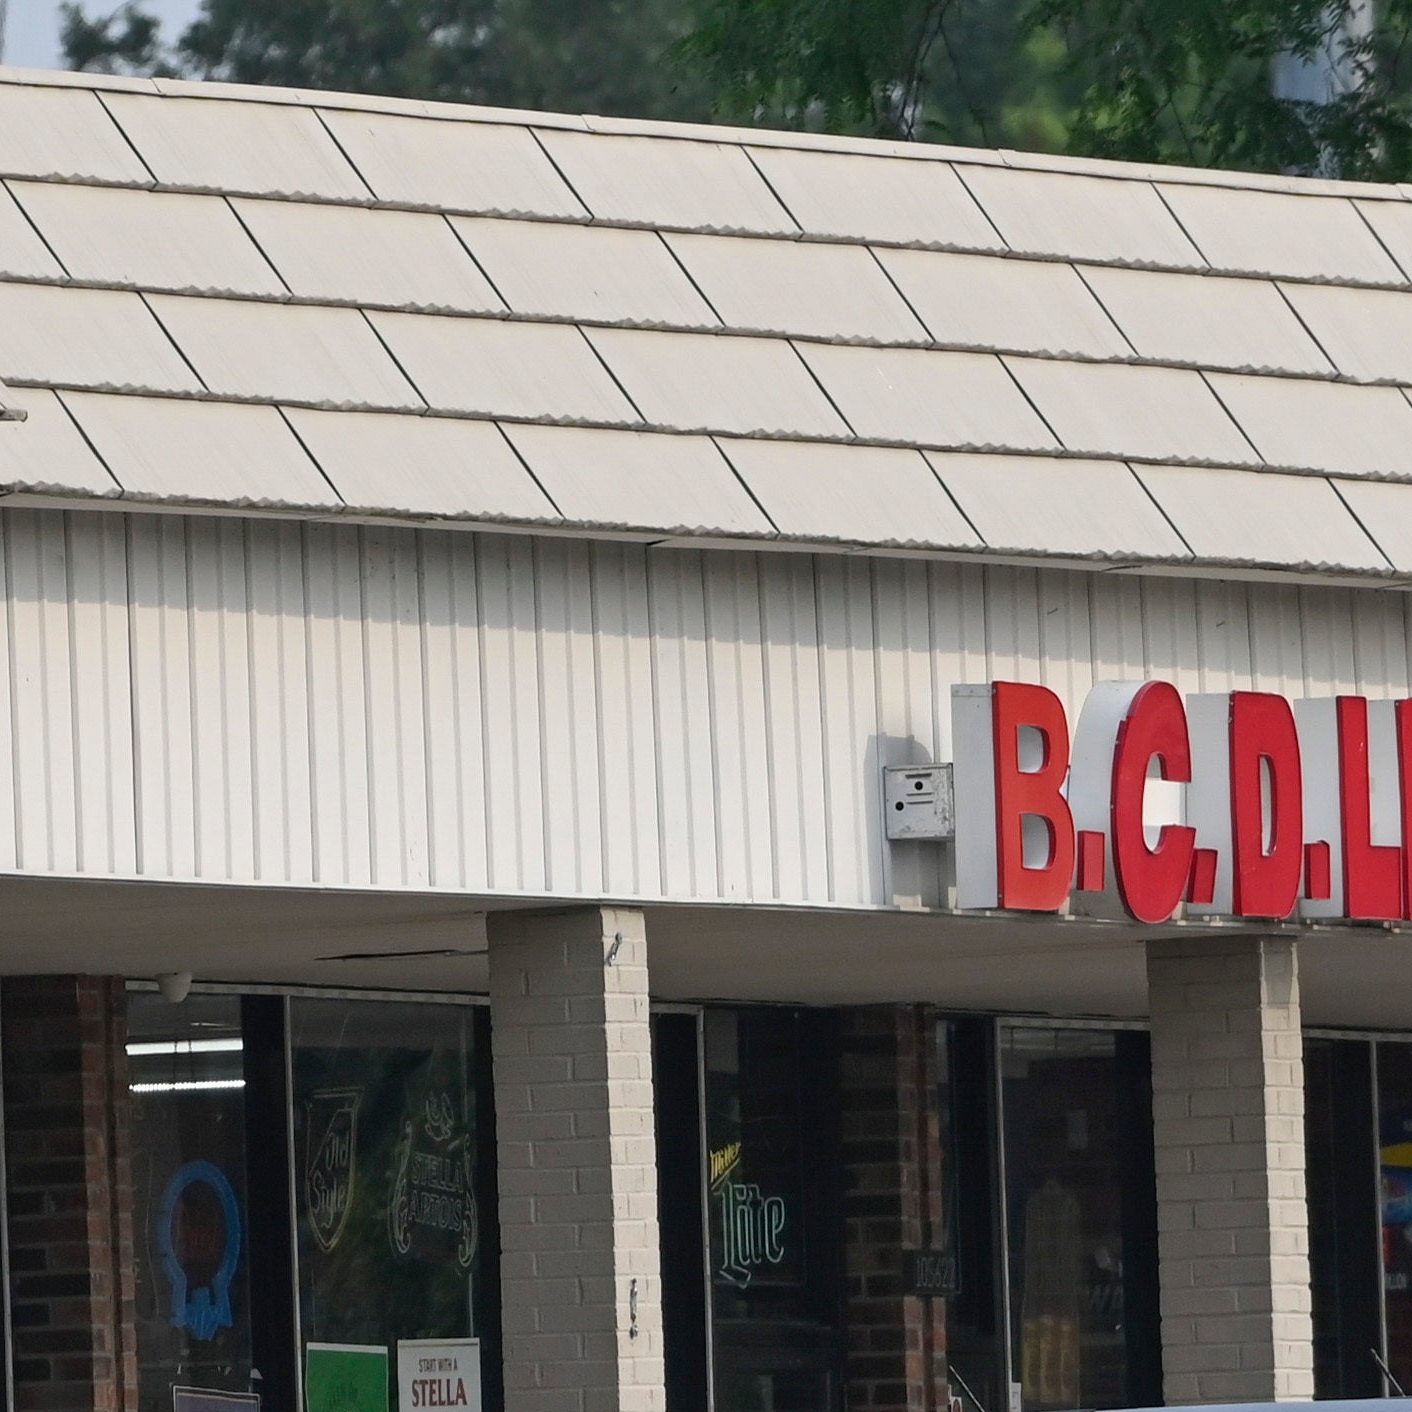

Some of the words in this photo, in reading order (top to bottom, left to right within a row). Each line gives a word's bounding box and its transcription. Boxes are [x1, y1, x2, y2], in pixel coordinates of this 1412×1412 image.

[411, 1151, 464, 1194] STELLA
[713, 1181, 786, 1289] Lite
[411, 1378, 468, 1407] STELLA
